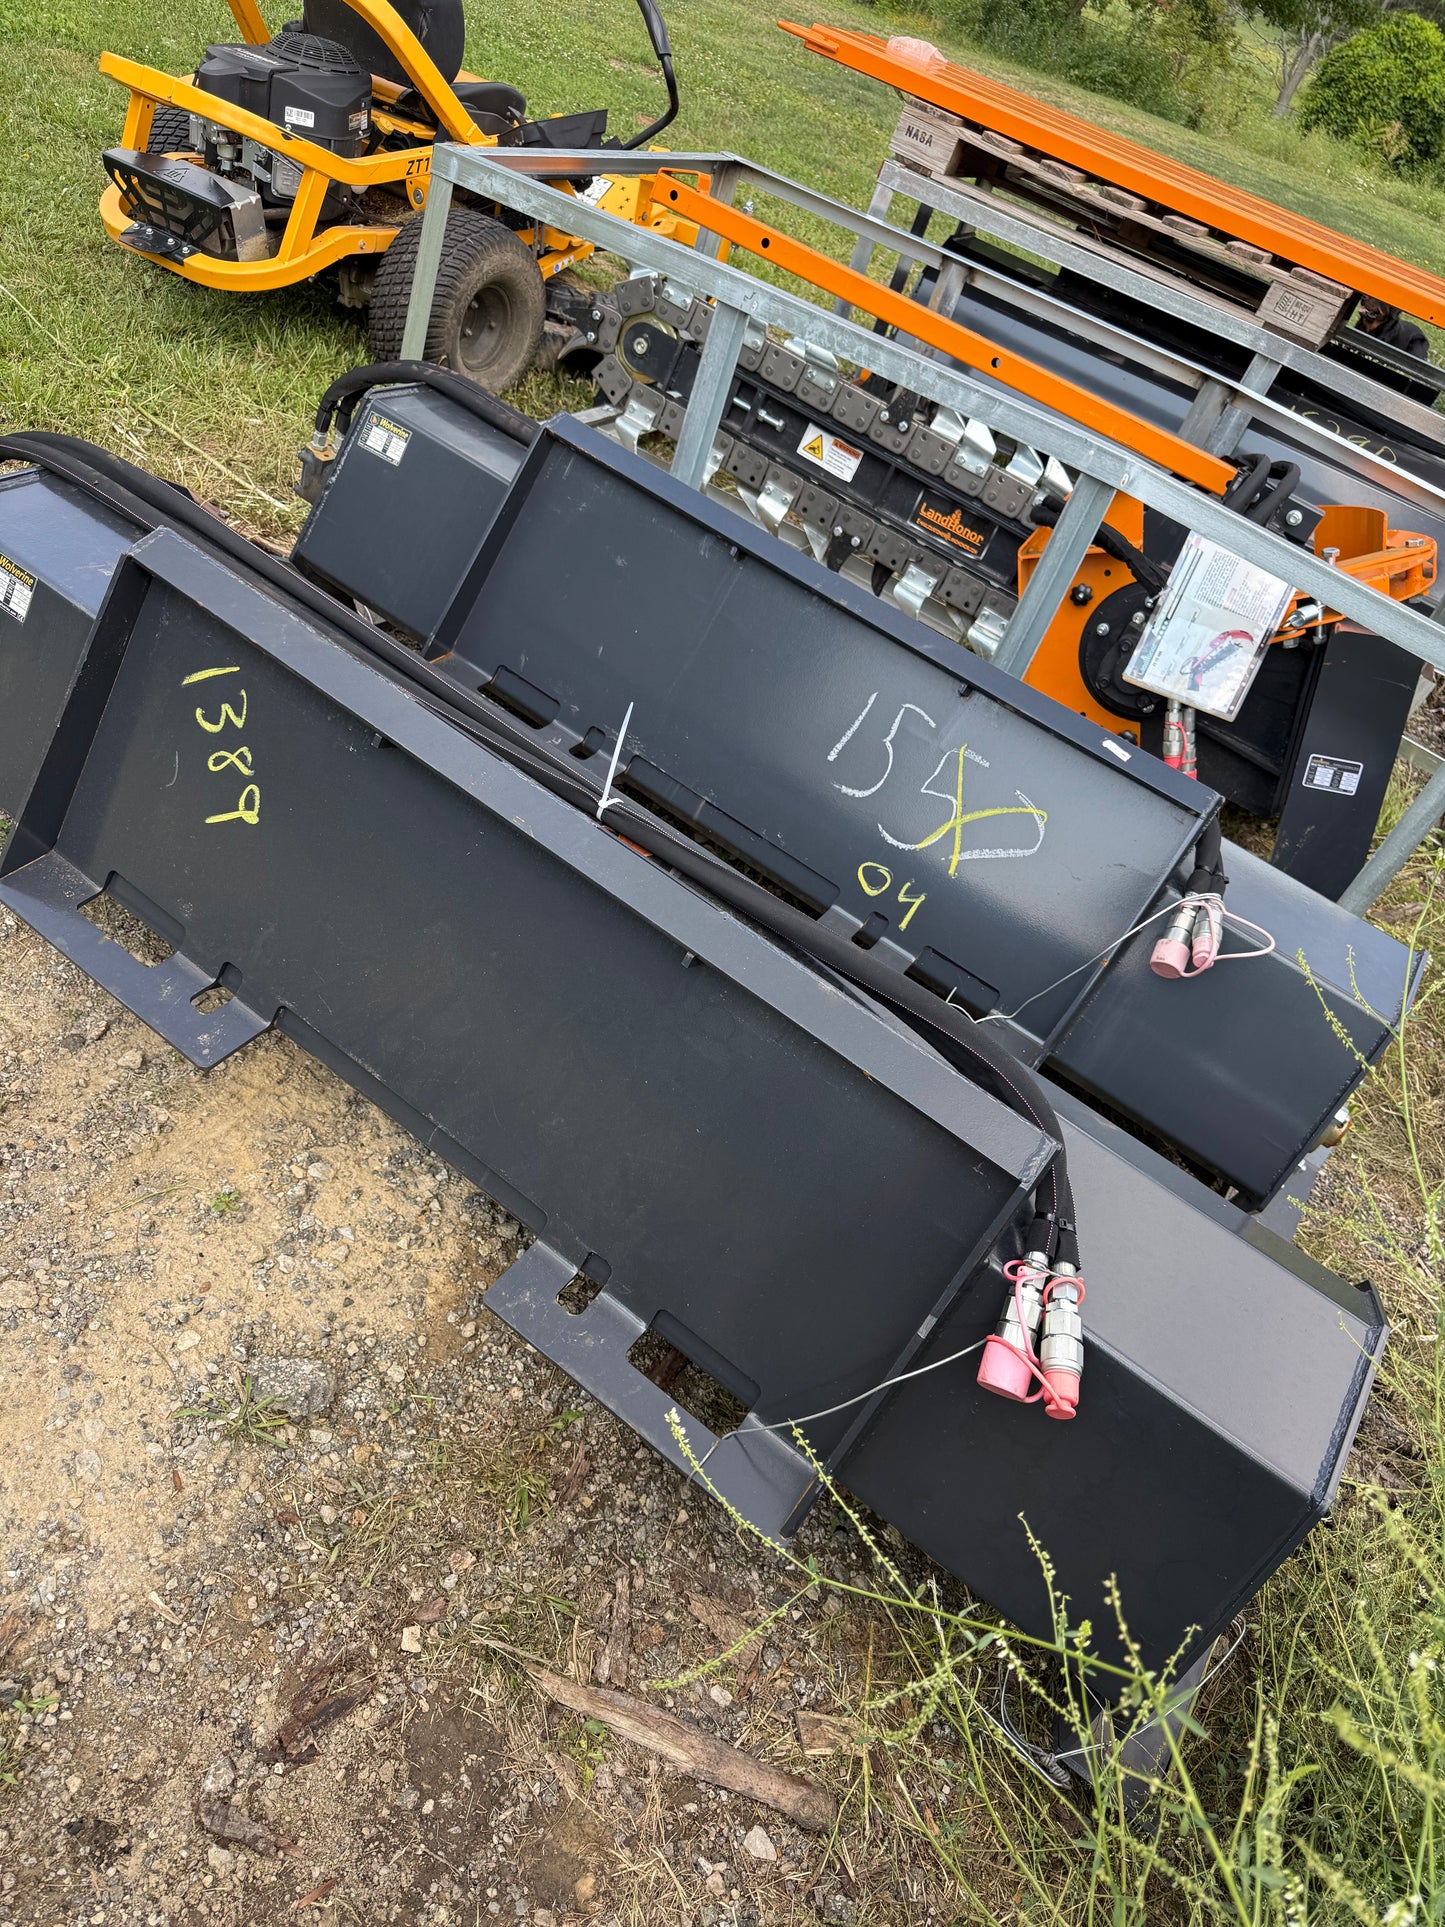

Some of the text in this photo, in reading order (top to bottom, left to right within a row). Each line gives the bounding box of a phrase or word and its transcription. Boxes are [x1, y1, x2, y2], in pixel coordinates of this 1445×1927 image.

[905, 125, 933, 147] NASA
[919, 502, 984, 546] LandHonor
[0, 556, 34, 586] Wolverine
[181, 666, 261, 825] 1389
[858, 861, 928, 931] 04
